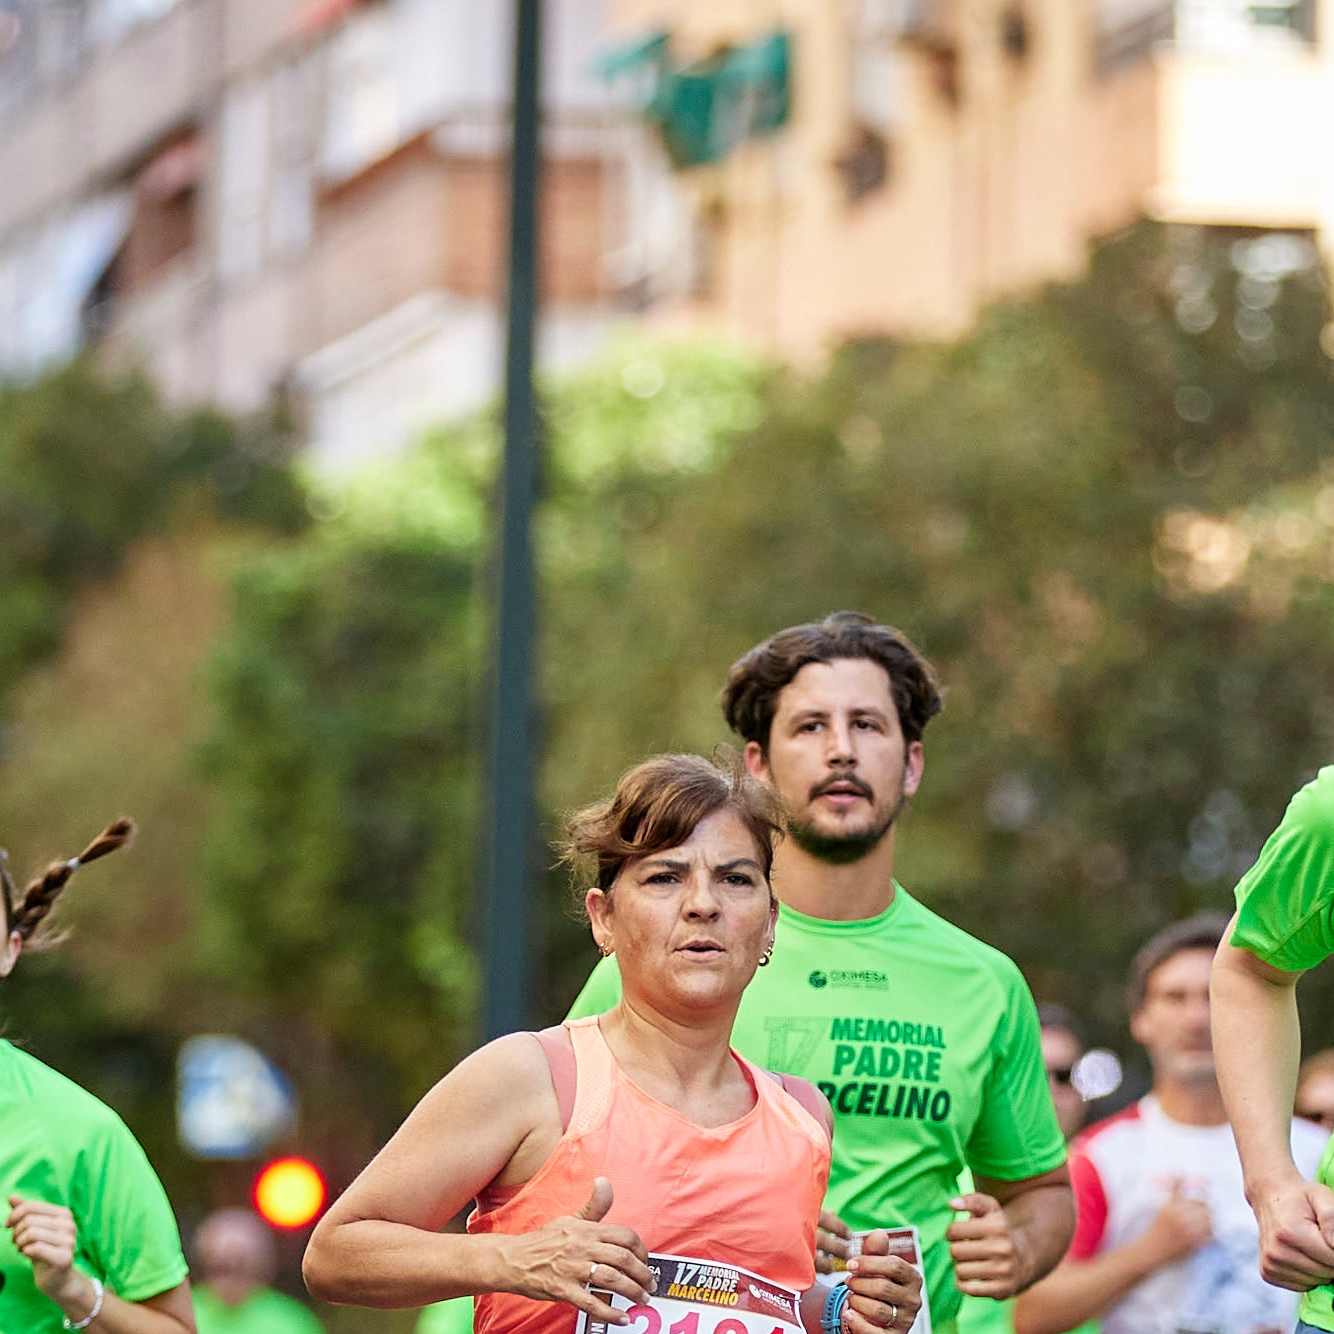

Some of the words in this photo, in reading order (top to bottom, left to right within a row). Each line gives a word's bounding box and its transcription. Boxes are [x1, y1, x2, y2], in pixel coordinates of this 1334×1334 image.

[830, 1018, 947, 1049] MEMORIAL
[833, 1045, 943, 1083] PADRE
[818, 1081, 952, 1122] CELINO
[674, 1263, 699, 1286] 17
[698, 1266, 740, 1281] MEMORIAL
[697, 1277, 737, 1293] PADRE
[668, 1284, 739, 1306] MARCELINO
